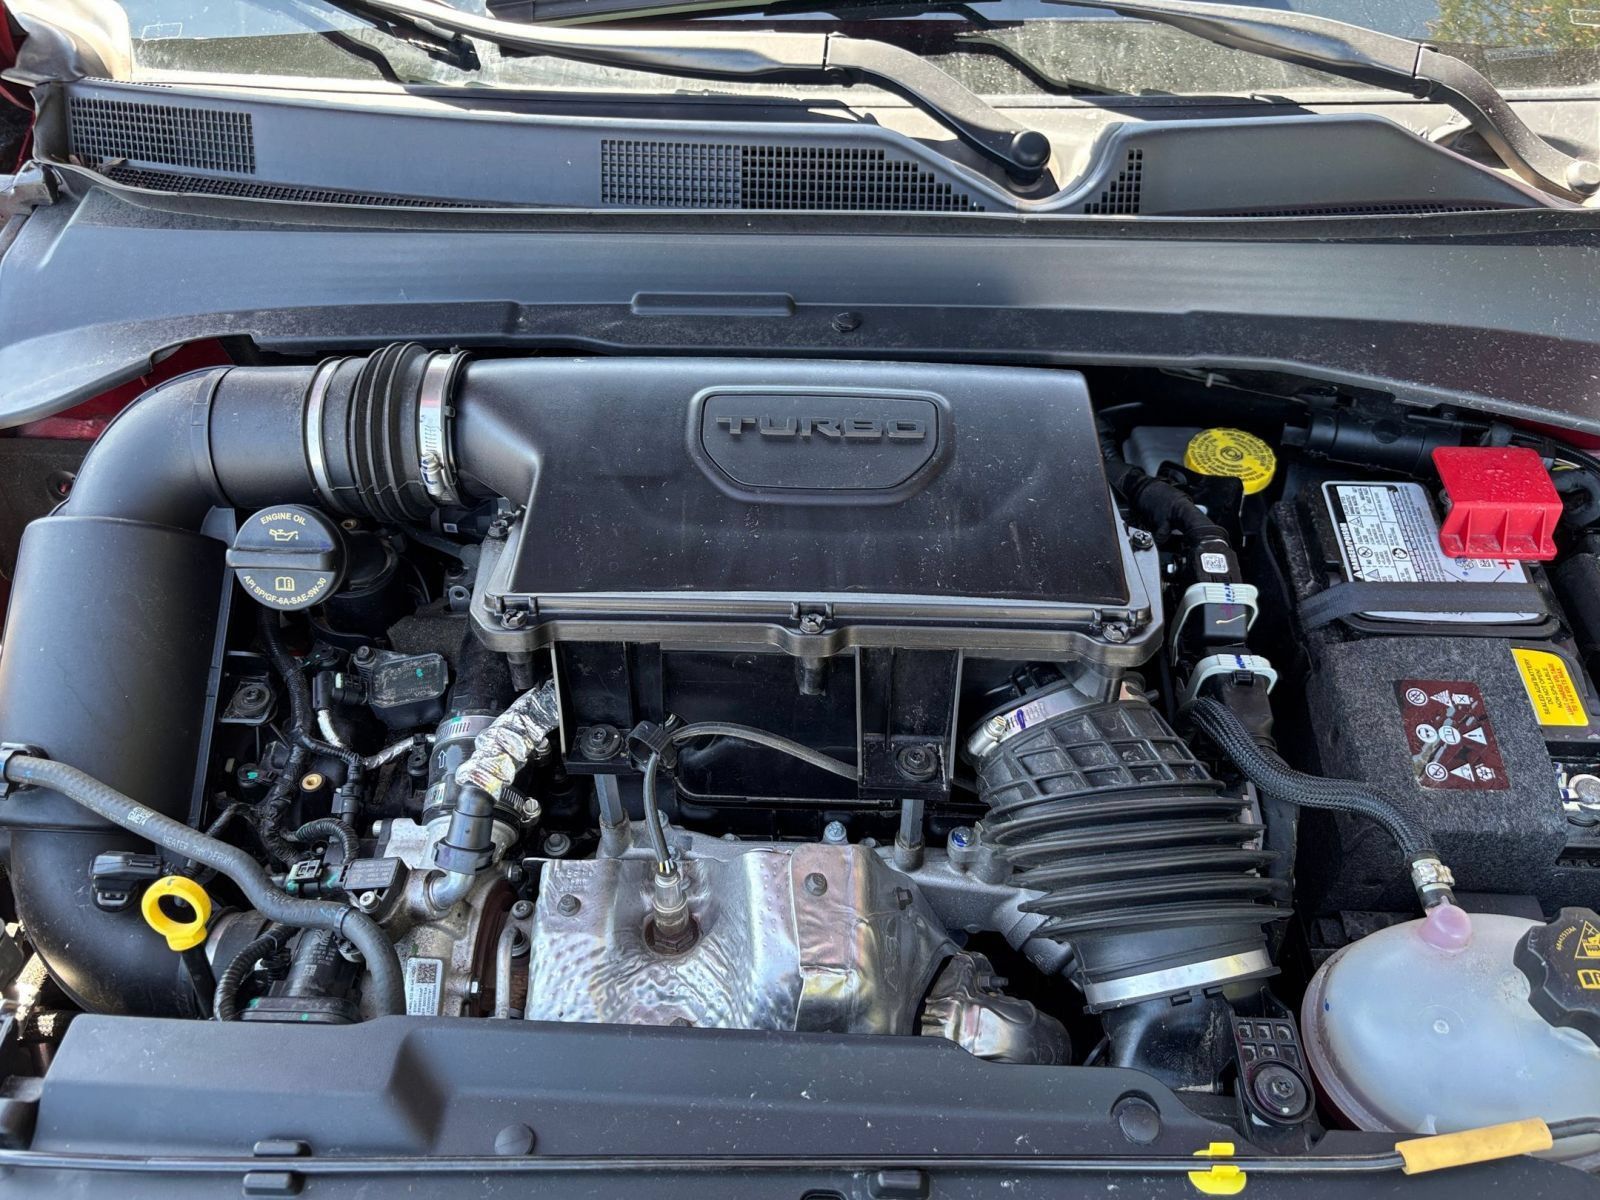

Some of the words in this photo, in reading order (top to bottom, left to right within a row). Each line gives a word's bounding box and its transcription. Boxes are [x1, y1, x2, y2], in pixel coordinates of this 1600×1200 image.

[716, 416, 926, 439] TURBO
[260, 512, 292, 525] ENGINE
[293, 514, 306, 526] OIL
[243, 576, 256, 588] API
[1524, 658, 1536, 680] BATTERY
[1538, 694, 1550, 714] SEALED
